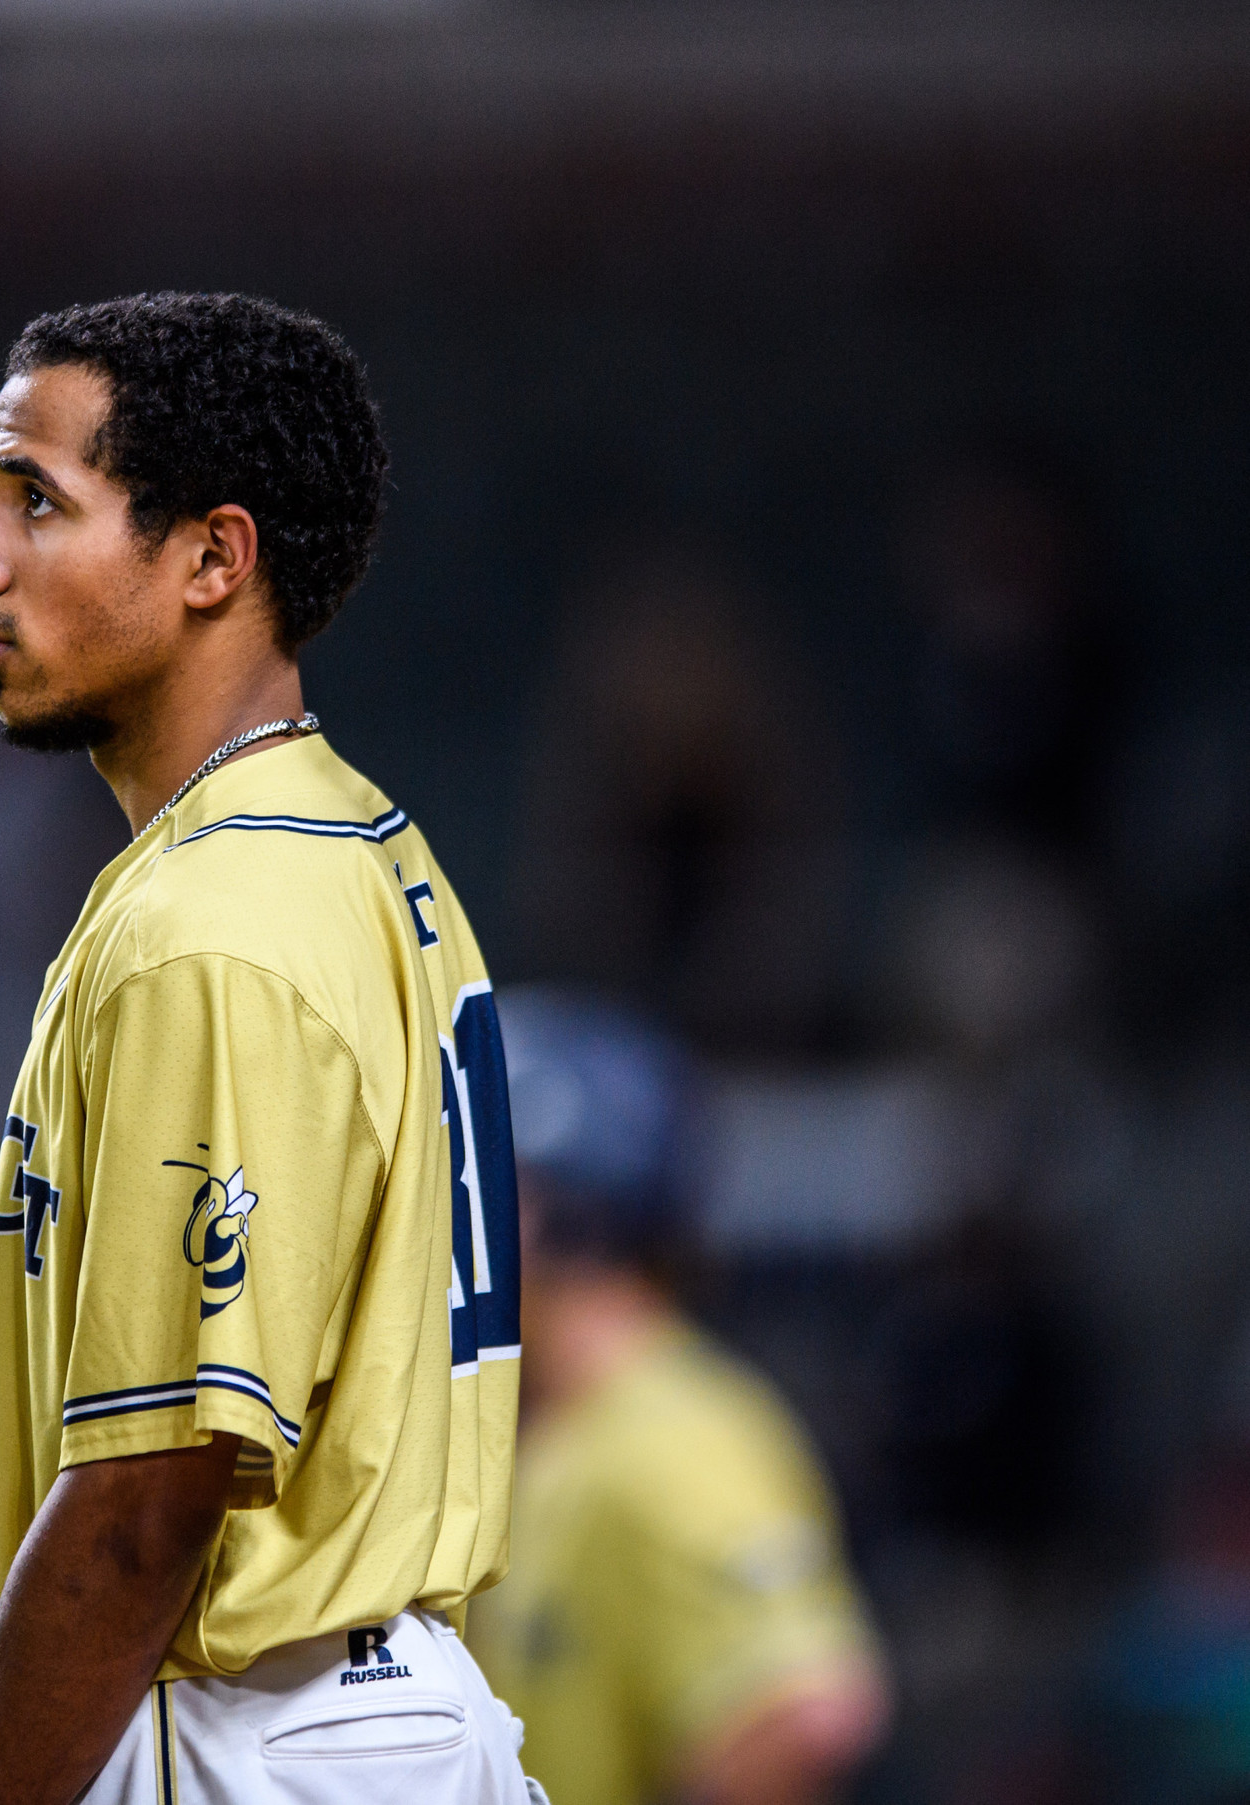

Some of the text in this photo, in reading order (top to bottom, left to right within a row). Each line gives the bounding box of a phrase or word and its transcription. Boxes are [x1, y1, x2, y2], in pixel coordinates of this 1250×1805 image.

[393, 860, 441, 950] T
[347, 1627, 394, 1667] R
[340, 1665, 413, 1687] RUSSELL
